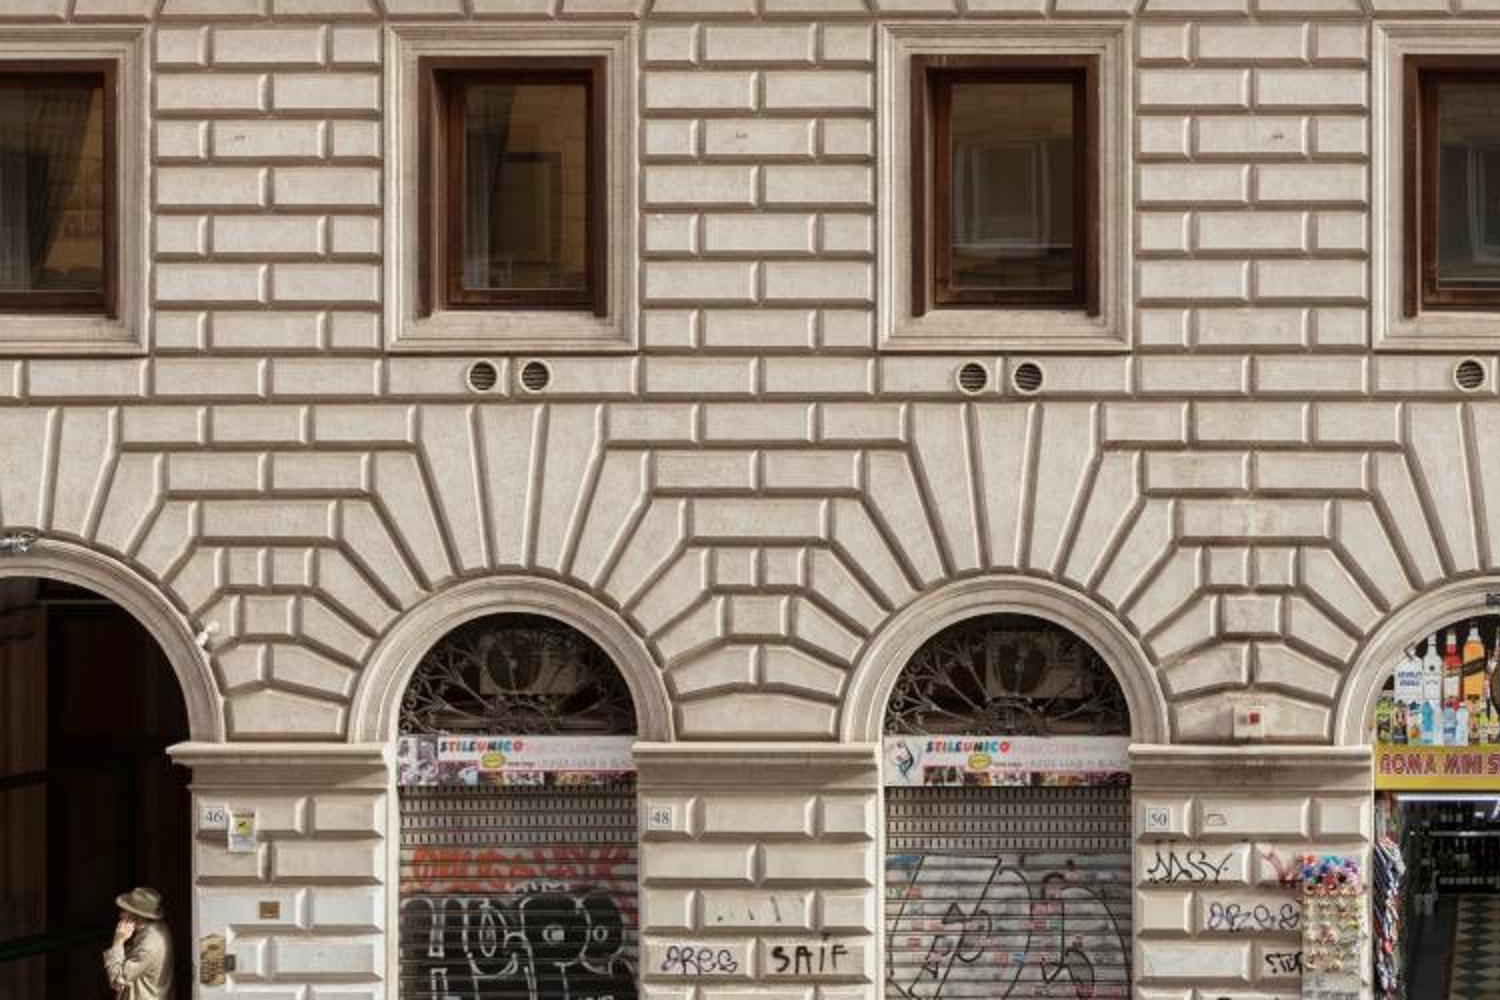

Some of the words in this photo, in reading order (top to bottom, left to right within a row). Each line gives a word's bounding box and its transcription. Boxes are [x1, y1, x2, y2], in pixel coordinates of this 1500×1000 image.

[206, 810, 224, 824] 46
[653, 810, 671, 826] 48
[1149, 811, 1168, 827] 50
